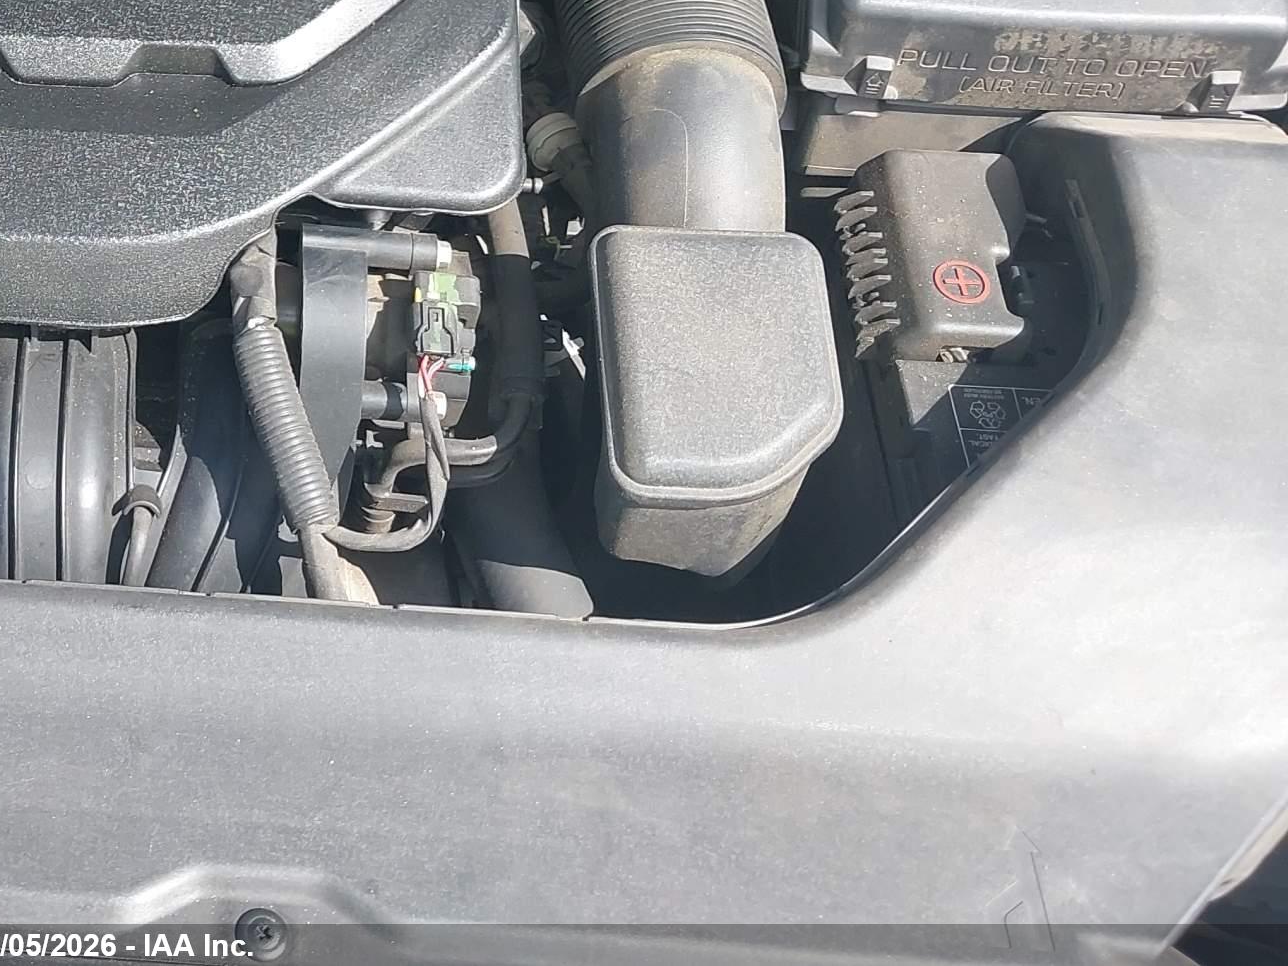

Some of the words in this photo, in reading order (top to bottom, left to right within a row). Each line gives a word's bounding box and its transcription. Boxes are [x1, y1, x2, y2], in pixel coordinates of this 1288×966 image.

[895, 47, 977, 72] PULL
[987, 54, 1058, 75] OUT
[1066, 57, 1110, 77] TO
[1114, 58, 1210, 79] OPEN
[1021, 79, 1126, 101] FILTER)
